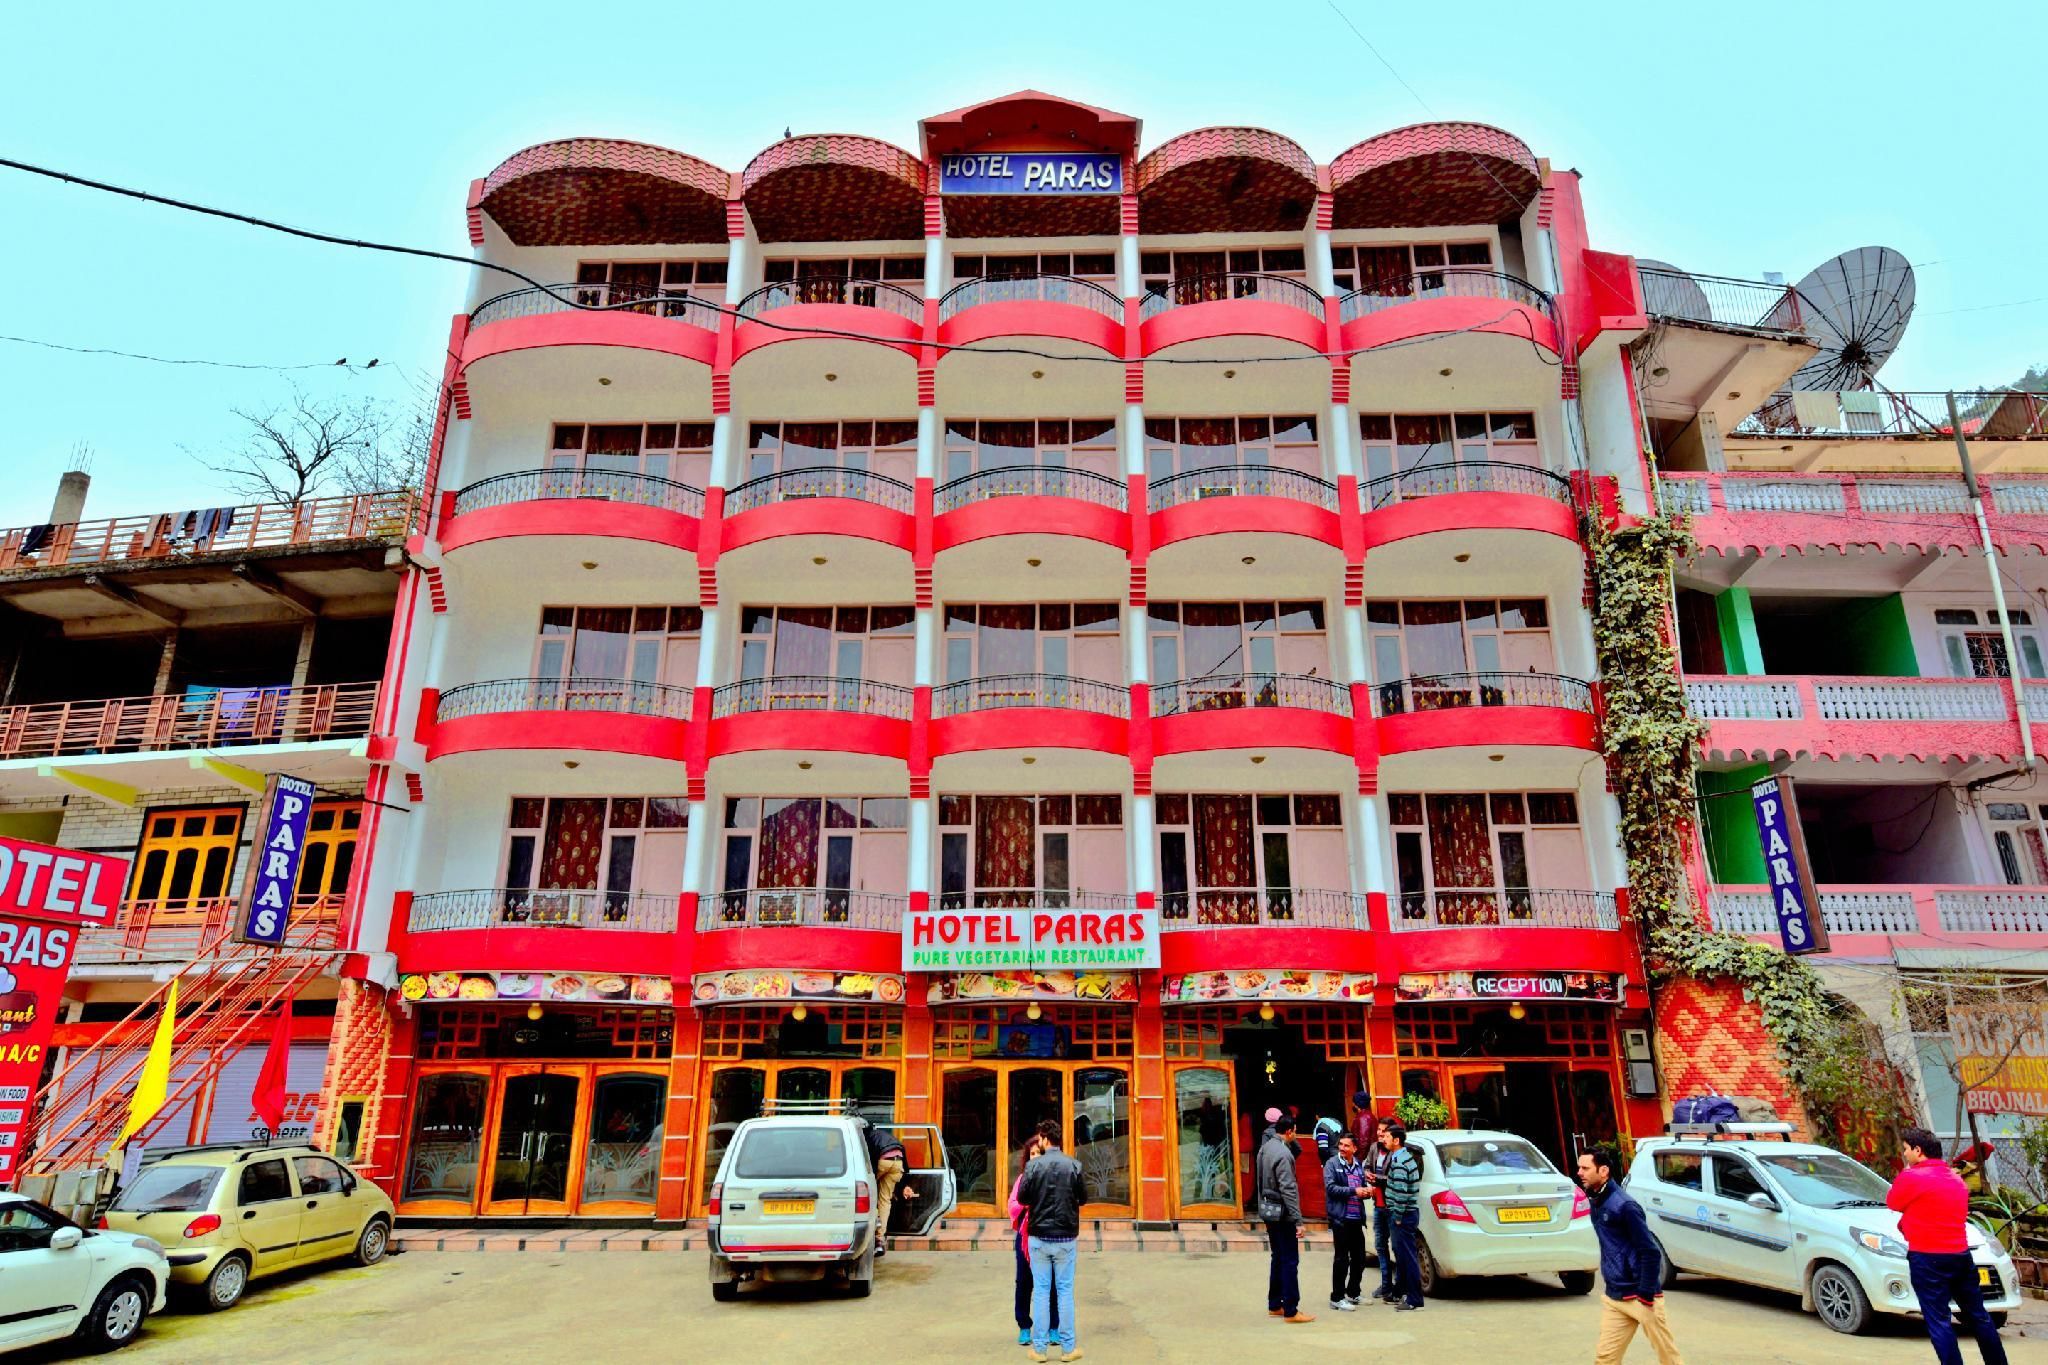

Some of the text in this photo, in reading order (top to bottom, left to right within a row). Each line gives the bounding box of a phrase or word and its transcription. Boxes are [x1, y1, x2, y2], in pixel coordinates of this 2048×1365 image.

[946, 155, 1113, 191] HOTEL PARAS
[279, 775, 312, 797] HOTEL
[1752, 779, 1779, 799] HOTEL
[254, 795, 303, 937] PARAS
[1760, 799, 1806, 946] PARAS
[913, 913, 1146, 946] HOTEL PARAS
[913, 947, 1146, 965] PURE VEGETARIAN RESTAURANT
[1476, 977, 1563, 993] RECEPTION
[1947, 1010, 2048, 1057] DURG
[7, 1043, 41, 1065] A/C
[8, 1088, 27, 1099] FOOD
[252, 1126, 309, 1140] ceent
